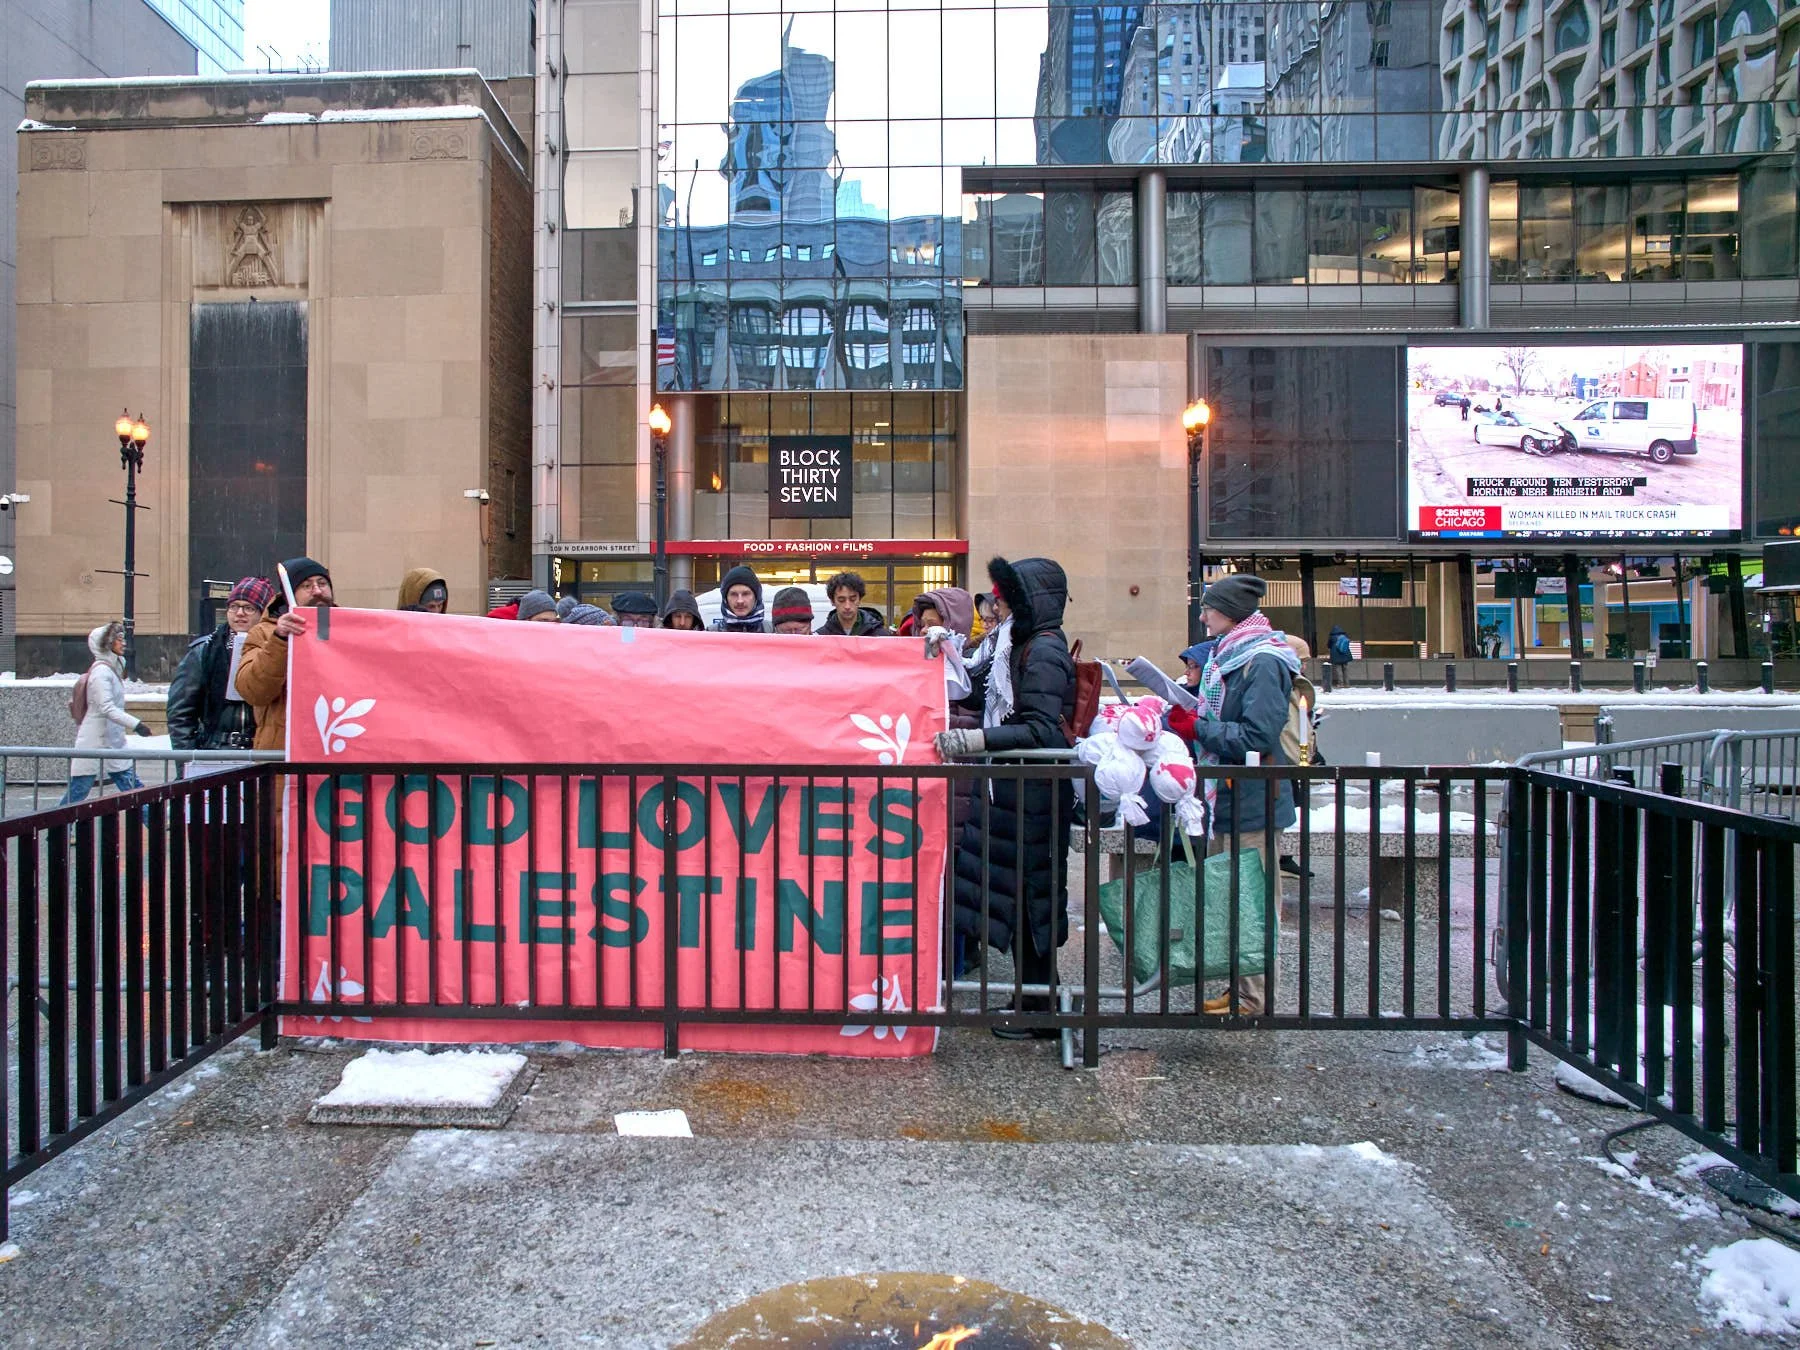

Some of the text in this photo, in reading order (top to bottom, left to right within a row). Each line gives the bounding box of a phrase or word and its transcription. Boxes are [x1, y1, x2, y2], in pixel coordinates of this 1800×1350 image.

[780, 450, 841, 466] BLOCK
[780, 468, 841, 484] THIRTY
[1472, 477, 1635, 487] TRUCK AROUND TEN YESTERDAY
[780, 486, 837, 503] SEVEN
[1472, 487, 1623, 496] MORNING NEAR MANHEIM AND
[1443, 508, 1485, 517] CBS NEWS
[1508, 510, 1677, 519] WOMAN KILLED IN MAIL TRUCK CRASH
[1435, 517, 1486, 527] CHICAGO
[743, 543, 874, 551] FOOD FASHION FILMS
[314, 774, 924, 860] GOD LOVES
[305, 864, 916, 956] PALESTINE
